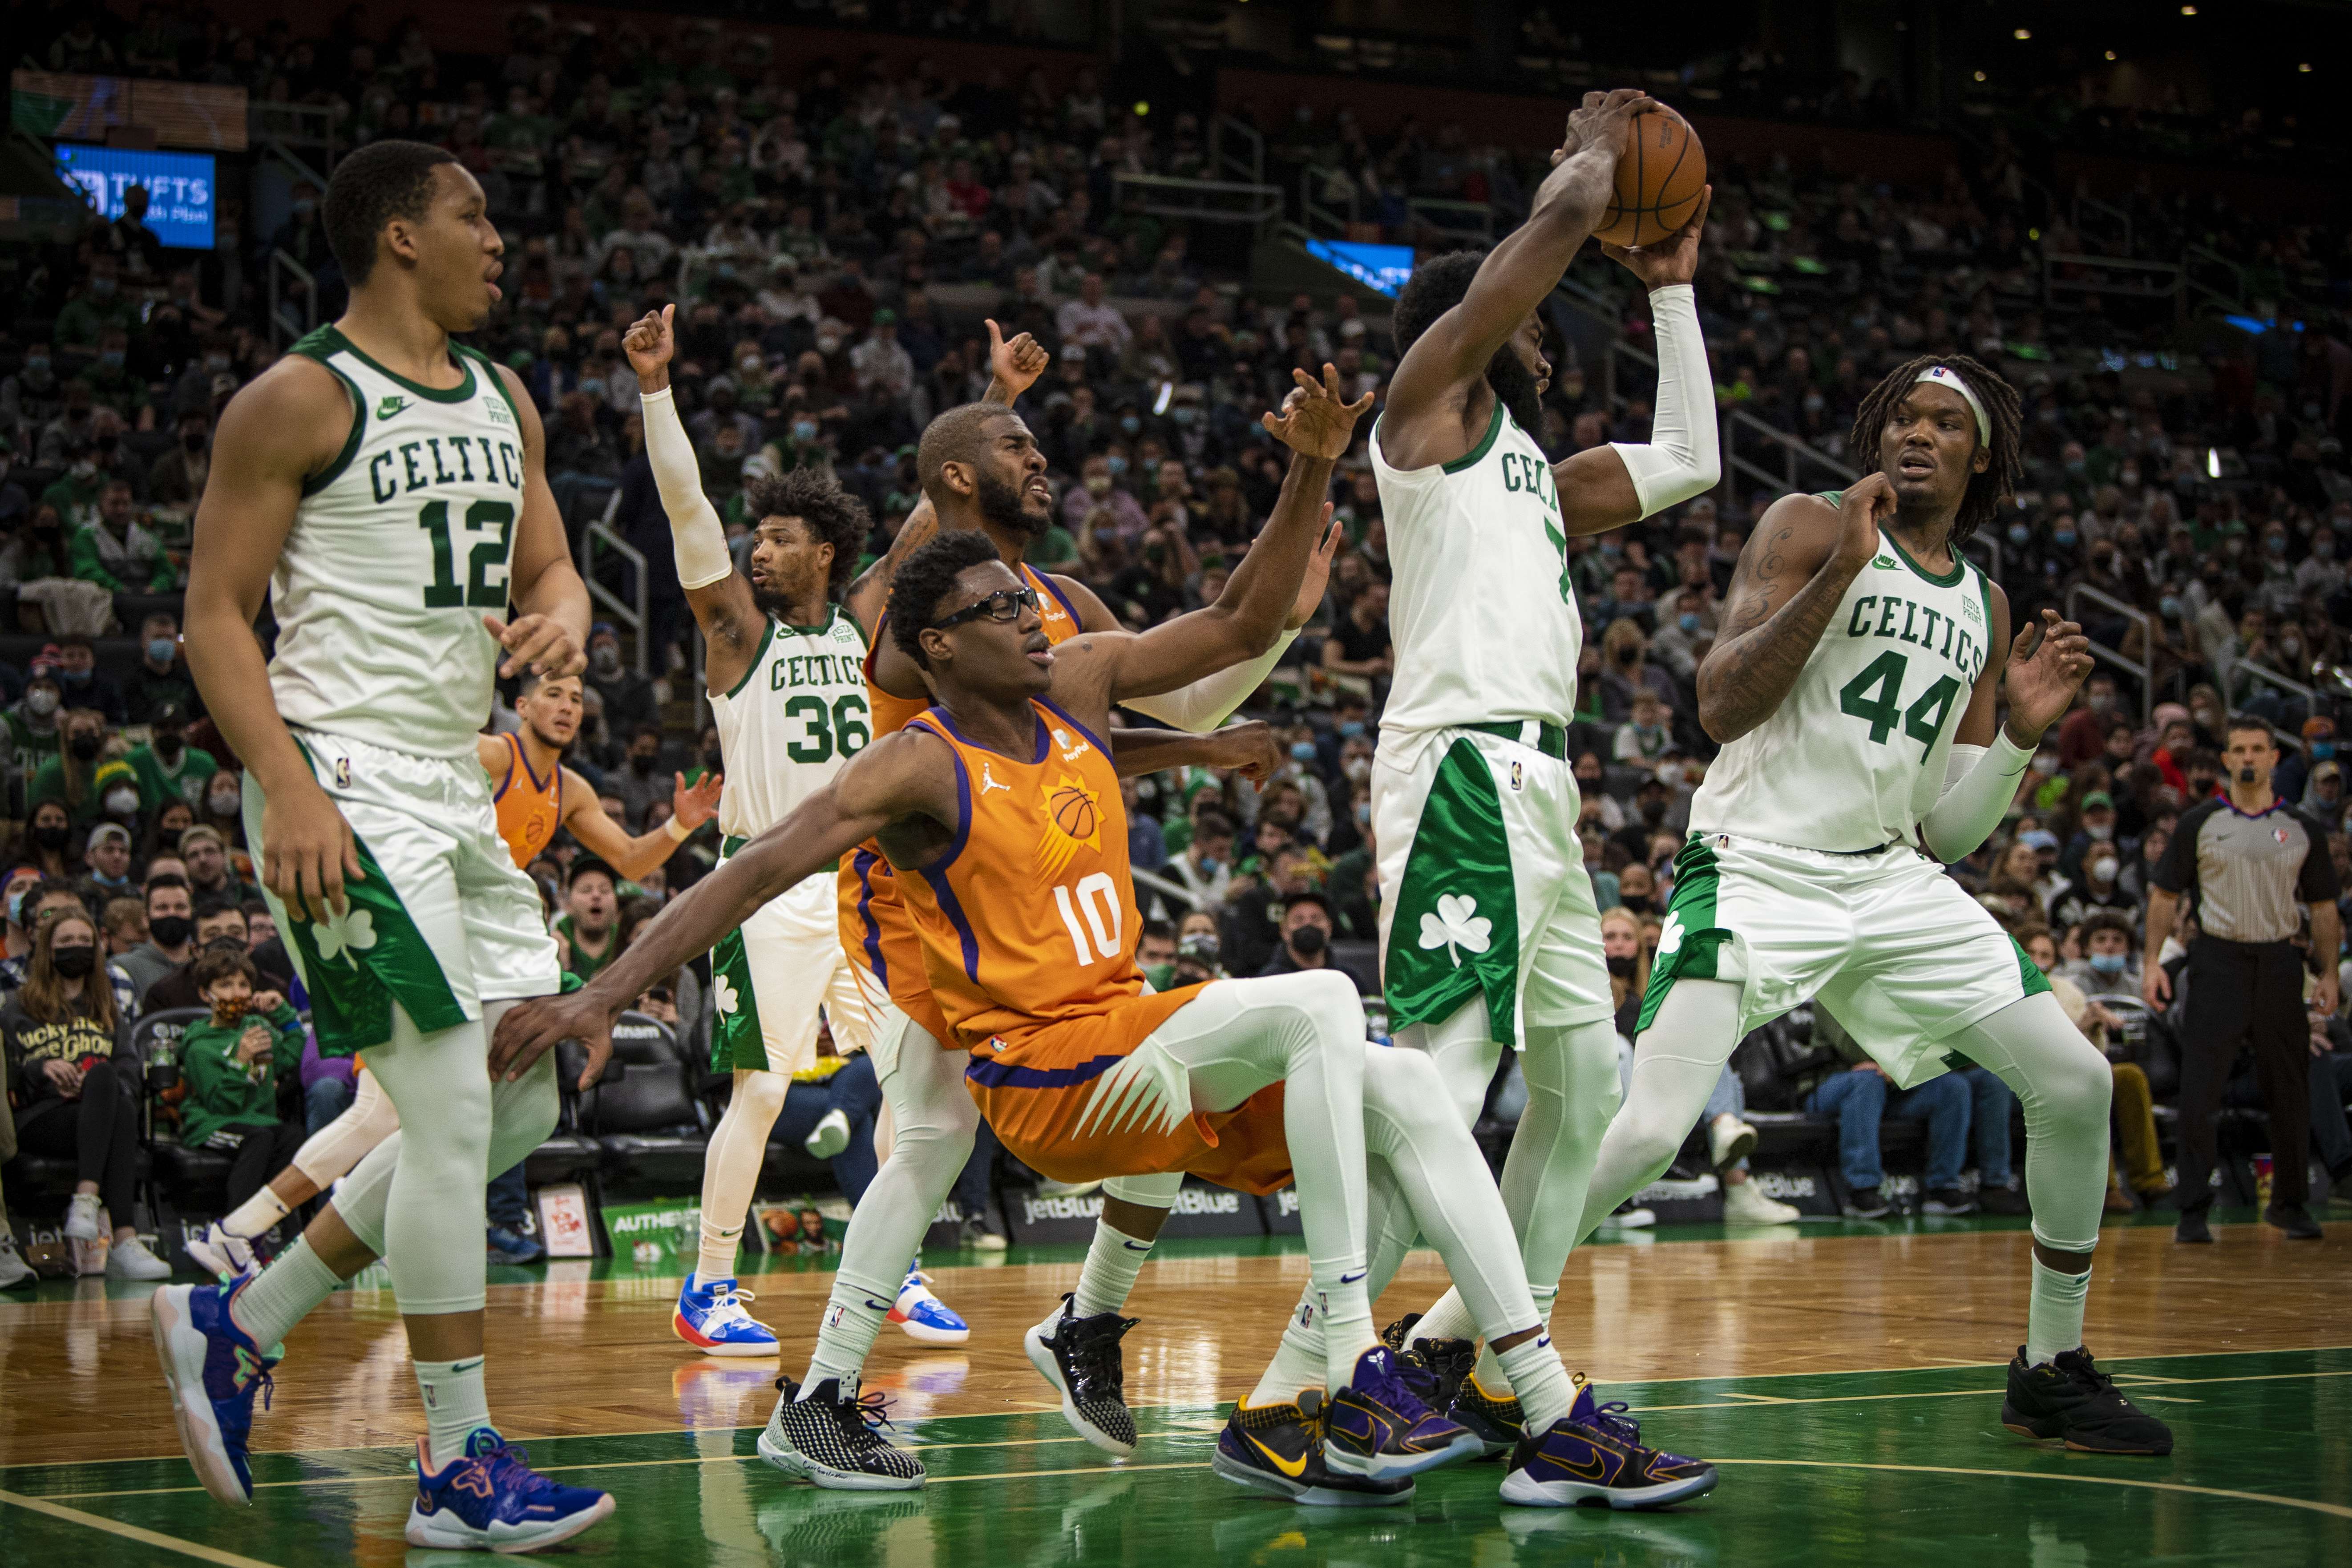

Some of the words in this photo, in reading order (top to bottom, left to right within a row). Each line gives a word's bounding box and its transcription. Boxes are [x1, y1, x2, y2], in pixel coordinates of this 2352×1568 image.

[370, 437, 525, 504] CELTIC
[420, 501, 515, 608] 12
[1878, 554, 1897, 567] NIKE
[834, 633, 856, 644] PRINT
[1961, 594, 1982, 618] VISTA
[1963, 606, 1982, 627] PRINT
[1847, 595, 1983, 692] CELTICS
[785, 695, 869, 764] 36
[1840, 650, 1961, 766] 44
[1063, 742, 1090, 762] PayPal
[1053, 872, 1122, 966] 10
